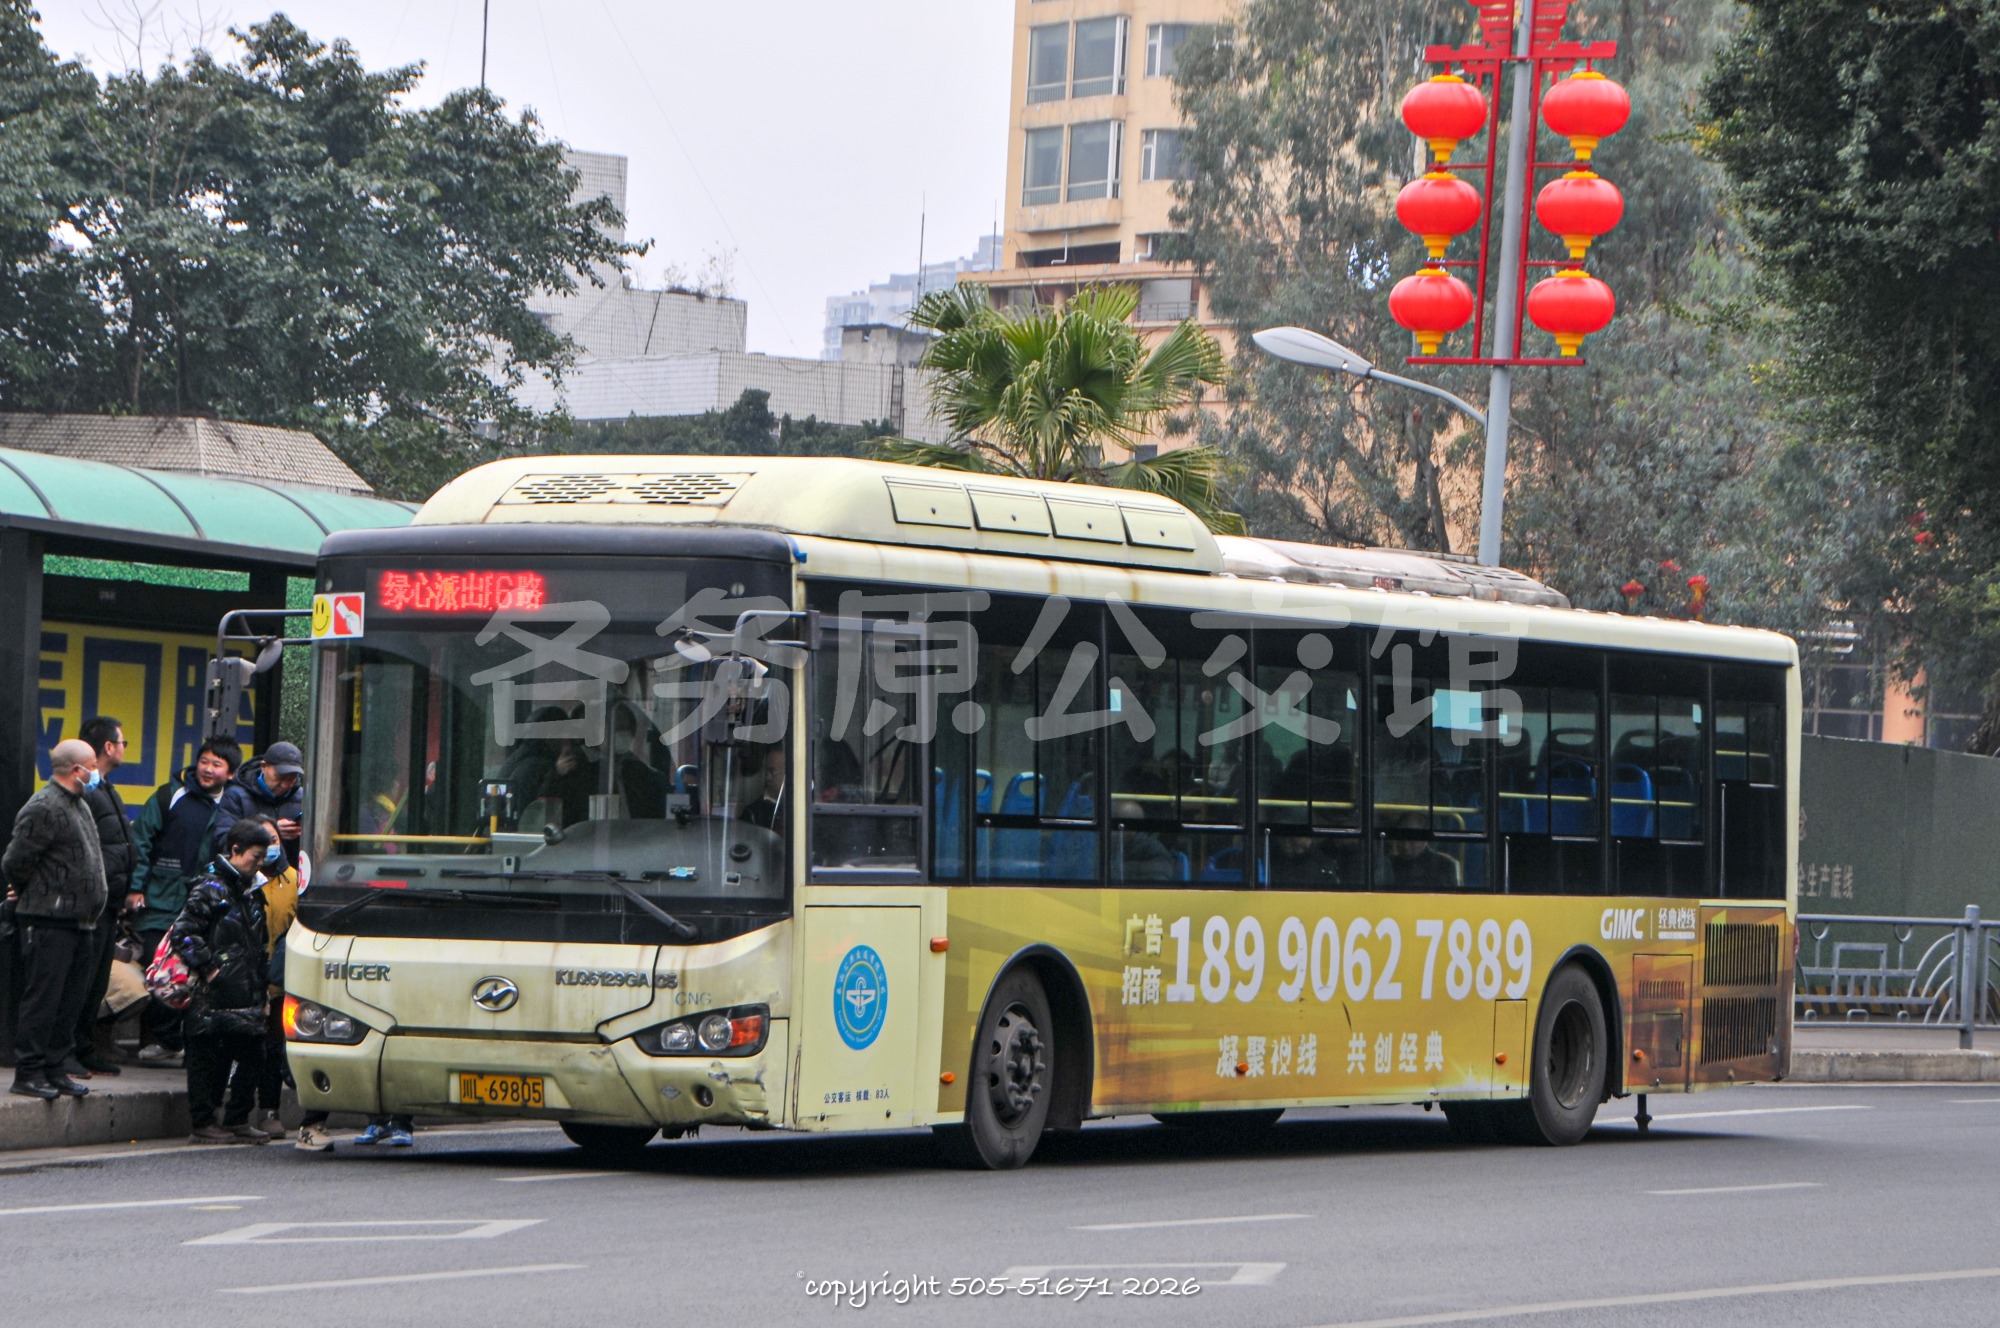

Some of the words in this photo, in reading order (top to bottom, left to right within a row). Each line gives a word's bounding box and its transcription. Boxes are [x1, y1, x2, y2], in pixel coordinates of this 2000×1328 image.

[1123, 913, 1163, 956] 广告
[1600, 908, 1645, 940] GIMC
[325, 961, 391, 982] HIGER
[1166, 915, 1265, 1002] 189
[1278, 916, 1403, 1001] 9062
[1416, 918, 1532, 1000] 7889
[675, 991, 712, 1006] CNG
[1121, 965, 1161, 1006] 招商
[1347, 1030, 1444, 1074] 共创经典
